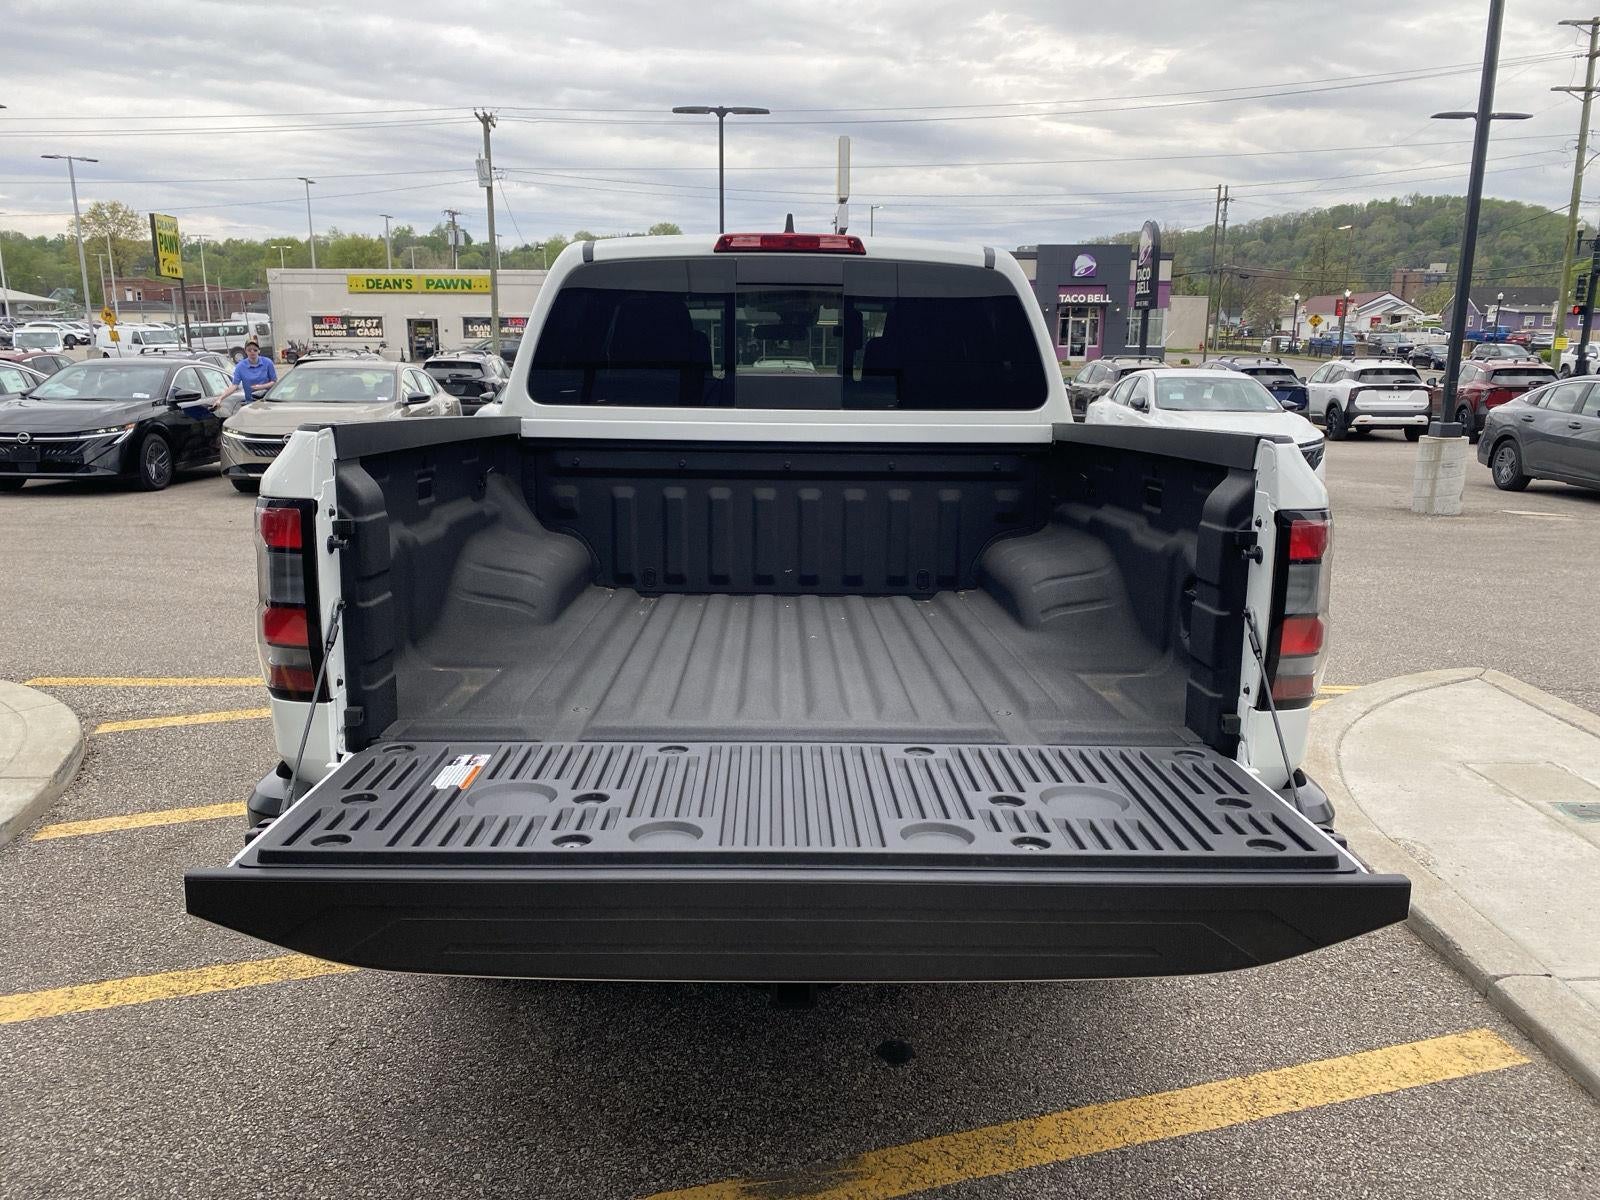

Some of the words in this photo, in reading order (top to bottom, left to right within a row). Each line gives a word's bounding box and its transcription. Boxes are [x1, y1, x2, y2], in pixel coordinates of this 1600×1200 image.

[159, 232, 179, 254] PAWN
[1137, 268, 1151, 281] TACO
[366, 278, 413, 290] DEAN'S
[425, 278, 472, 290] PAWN
[1136, 282, 1150, 294] BELL
[1059, 294, 1086, 303] TACO
[1087, 294, 1112, 303] BELL
[354, 319, 379, 328] FAST
